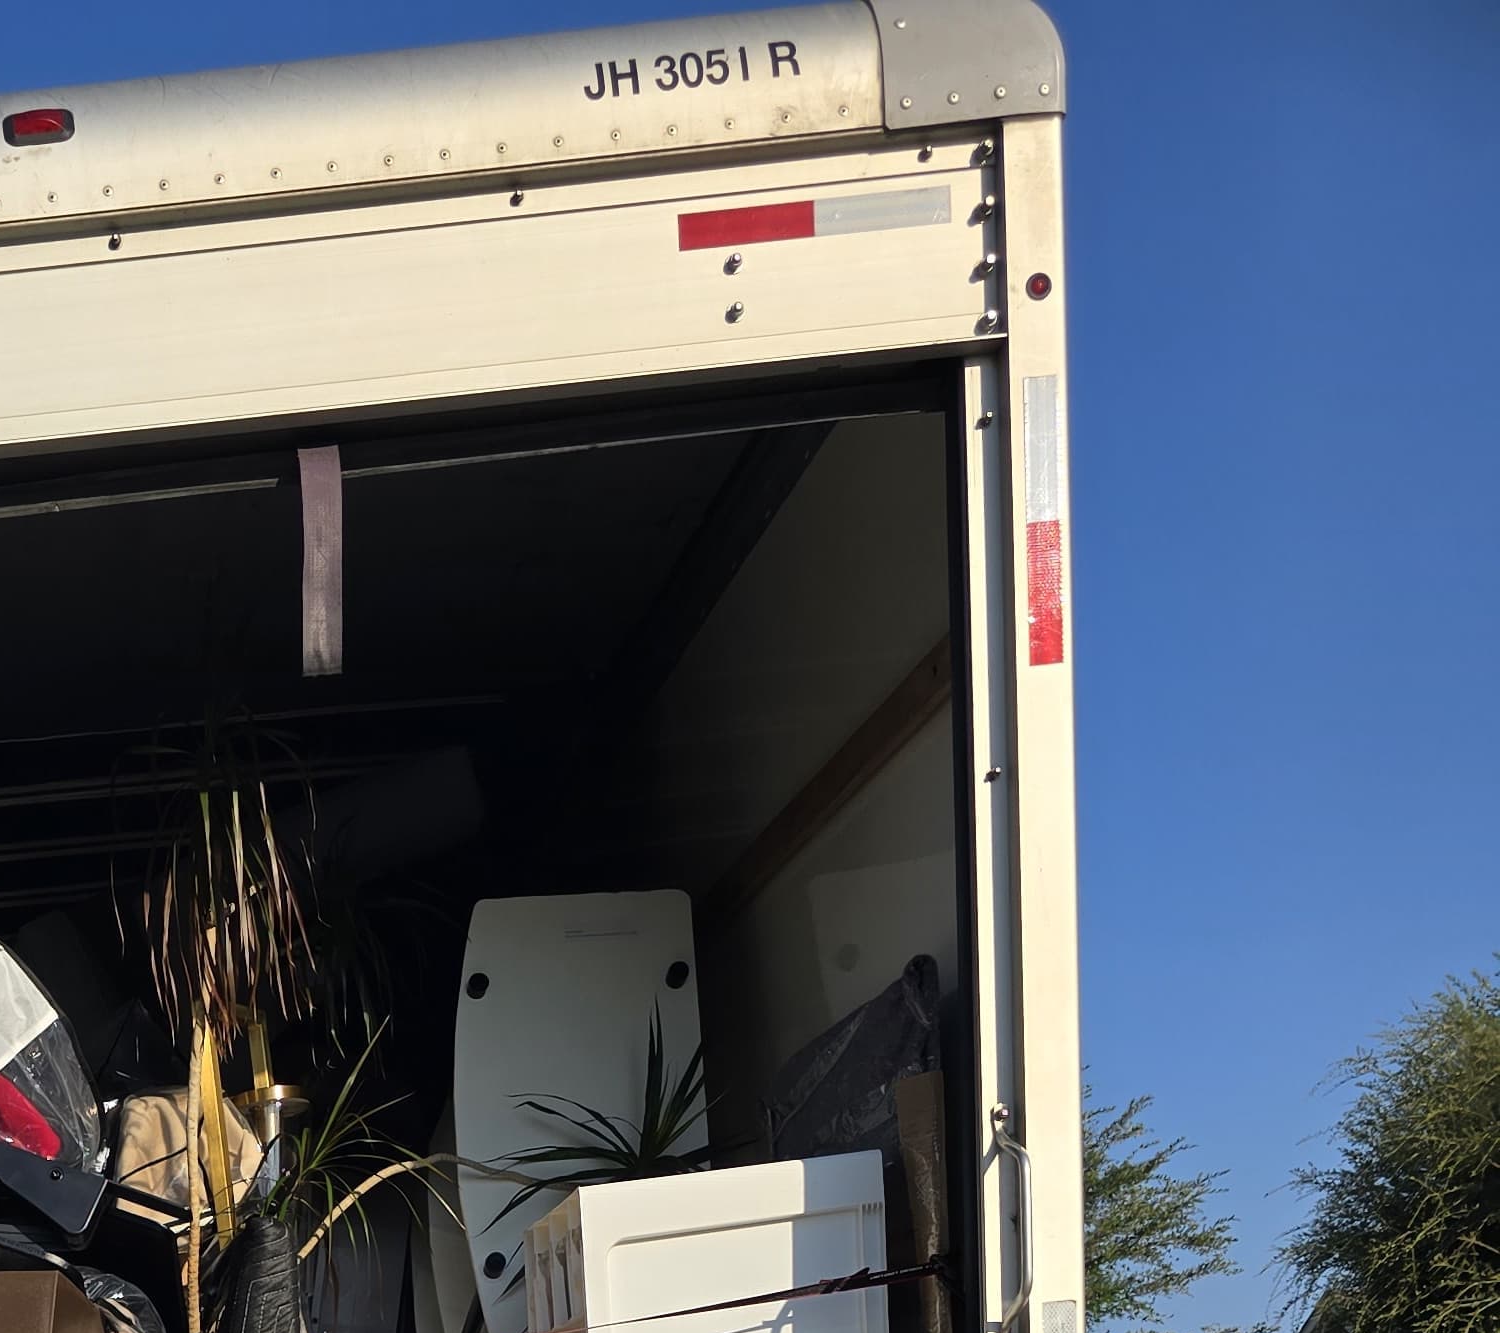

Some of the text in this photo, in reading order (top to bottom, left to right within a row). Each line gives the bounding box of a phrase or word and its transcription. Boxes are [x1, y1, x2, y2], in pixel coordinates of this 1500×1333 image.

[583, 41, 800, 100] JH 3051 R
